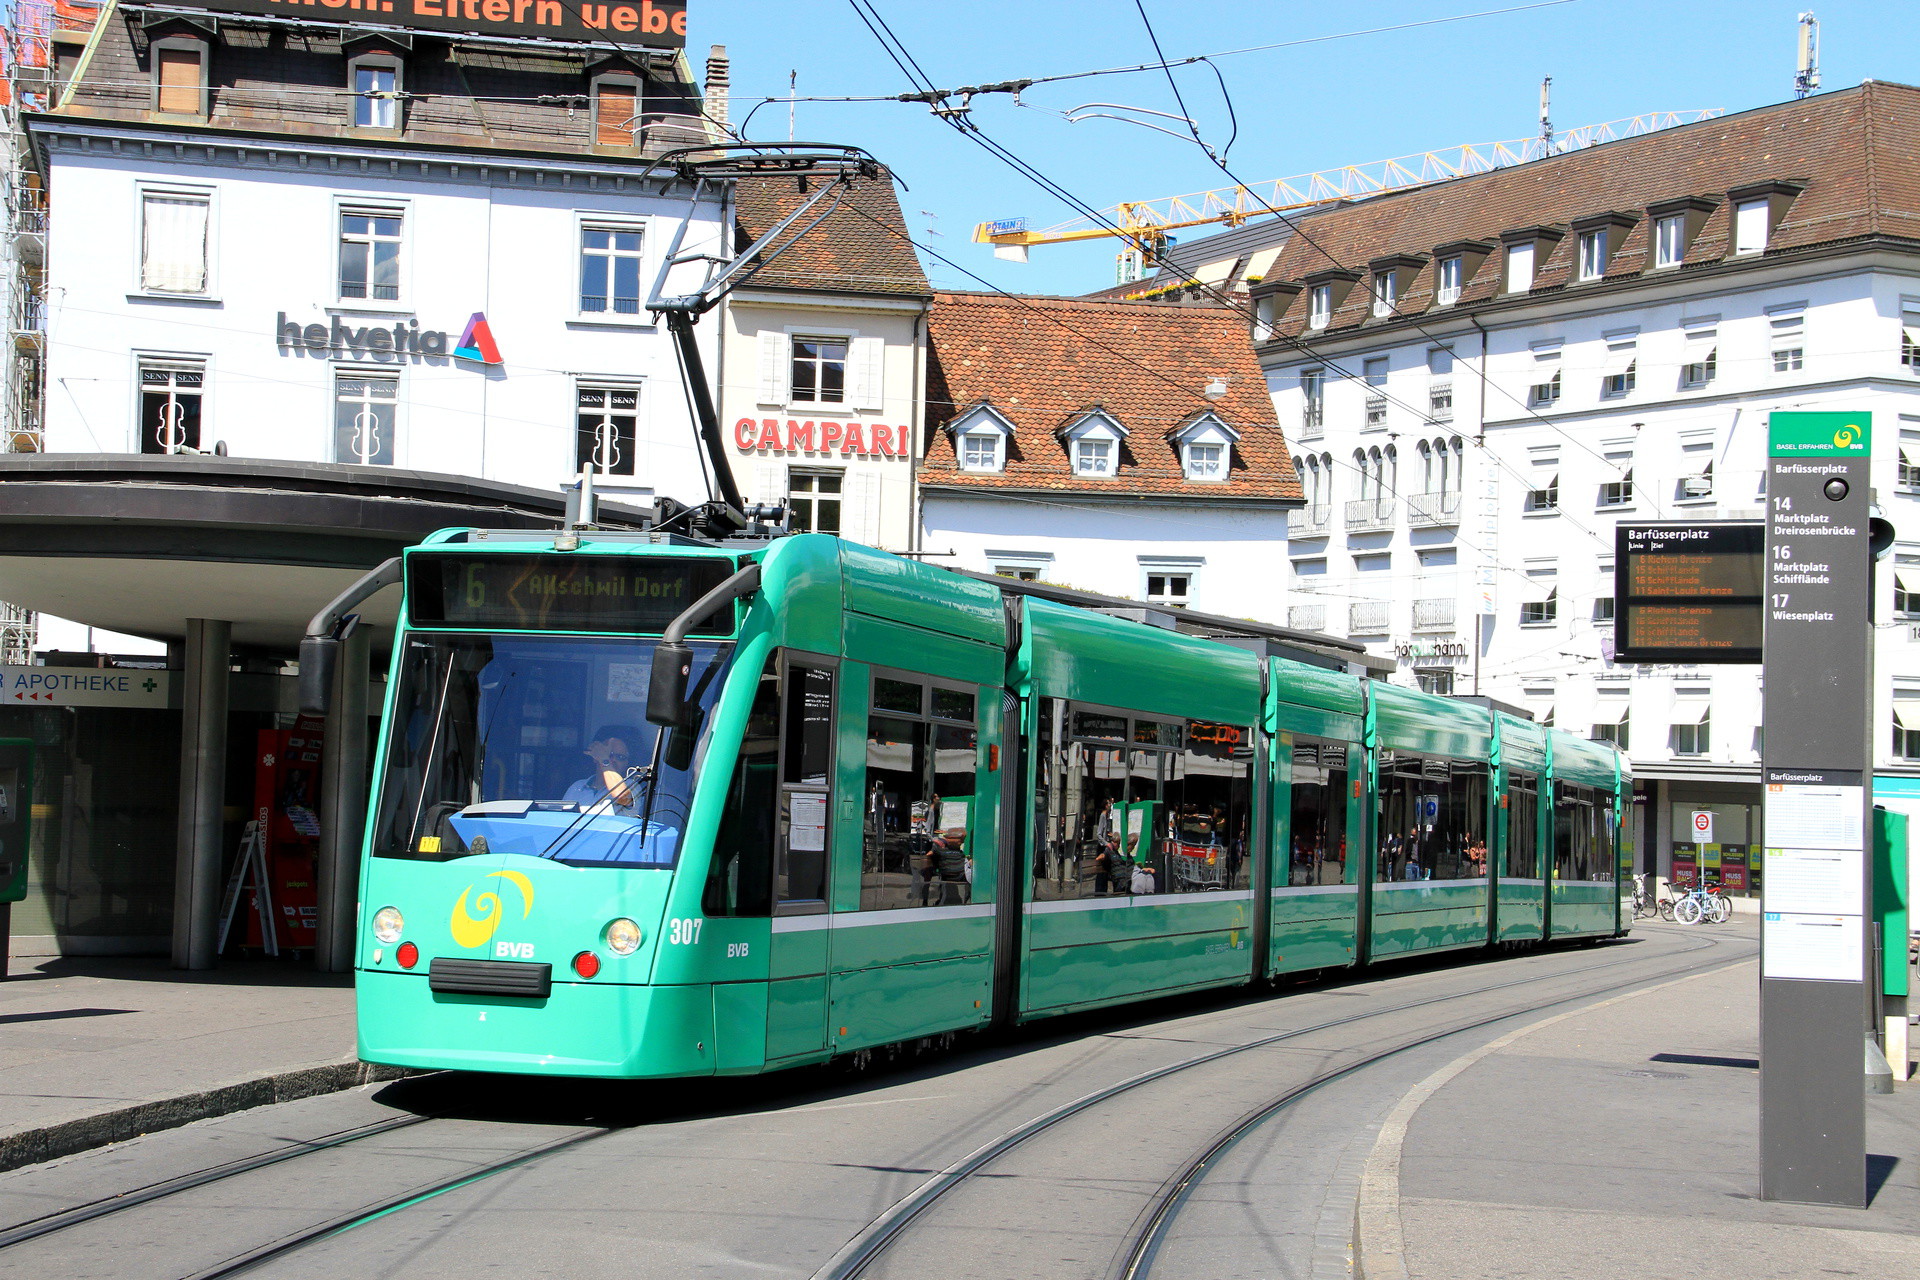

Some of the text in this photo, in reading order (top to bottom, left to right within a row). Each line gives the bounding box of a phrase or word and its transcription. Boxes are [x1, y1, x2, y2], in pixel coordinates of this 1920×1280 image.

[276, 311, 448, 355] helvetia
[144, 372, 201, 382] SENN SENN
[580, 394, 635, 405] SENN SENN
[734, 417, 909, 456] CAMPARI
[1775, 464, 1848, 476] Barfüsserplatz
[1773, 496, 1792, 511] 14
[1774, 513, 1830, 525] Marktplatz
[1628, 528, 1710, 542] Barfüsserplatz
[1774, 526, 1856, 536] Dreirosenbrücke
[1772, 545, 1791, 560] 16
[1639, 555, 1646, 564] 6
[1773, 562, 1829, 573] Marktplatz
[466, 563, 683, 608] 6 Allschwil Dorf
[1773, 574, 1830, 584] Schifflände
[1636, 586, 1646, 595] 11
[1771, 593, 1790, 608] 17
[1773, 610, 1834, 622] Wiesenplatz
[14, 673, 130, 692] APOTHEKE
[1770, 773, 1823, 783] Barfüsserplatz
[669, 918, 703, 945] 307
[496, 942, 535, 958] BVB
[727, 942, 749, 958] BVB
